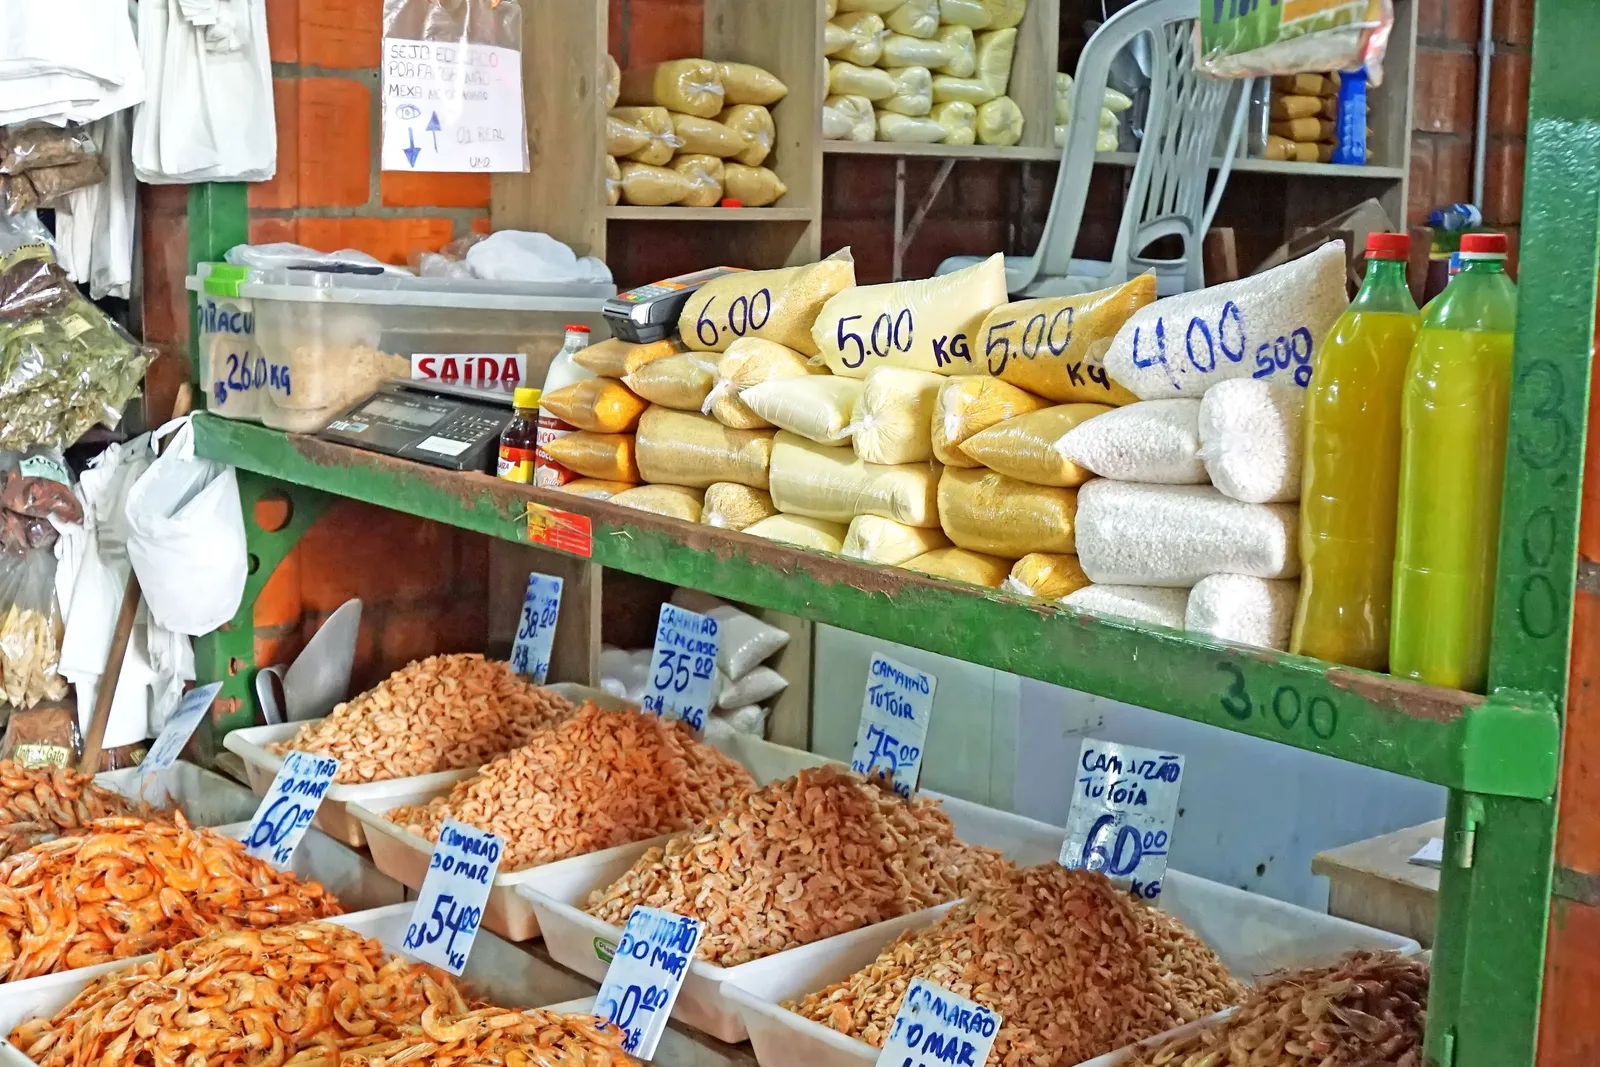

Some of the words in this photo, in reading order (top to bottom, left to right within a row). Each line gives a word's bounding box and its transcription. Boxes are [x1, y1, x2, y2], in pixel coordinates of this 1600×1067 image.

[389, 84, 422, 98] MEXA
[696, 288, 772, 347] 6.00
[837, 308, 914, 369] 5.00
[932, 333, 972, 368] KG
[986, 306, 1074, 377] 5.00
[1132, 300, 1245, 390] 4.00
[270, 364, 291, 396] KG
[1216, 661, 1338, 740] 3.00
[292, 779, 330, 799] MAR
[454, 861, 490, 884] MAR
[1130, 879, 1162, 899] KG
[922, 1031, 977, 1067] MAR
